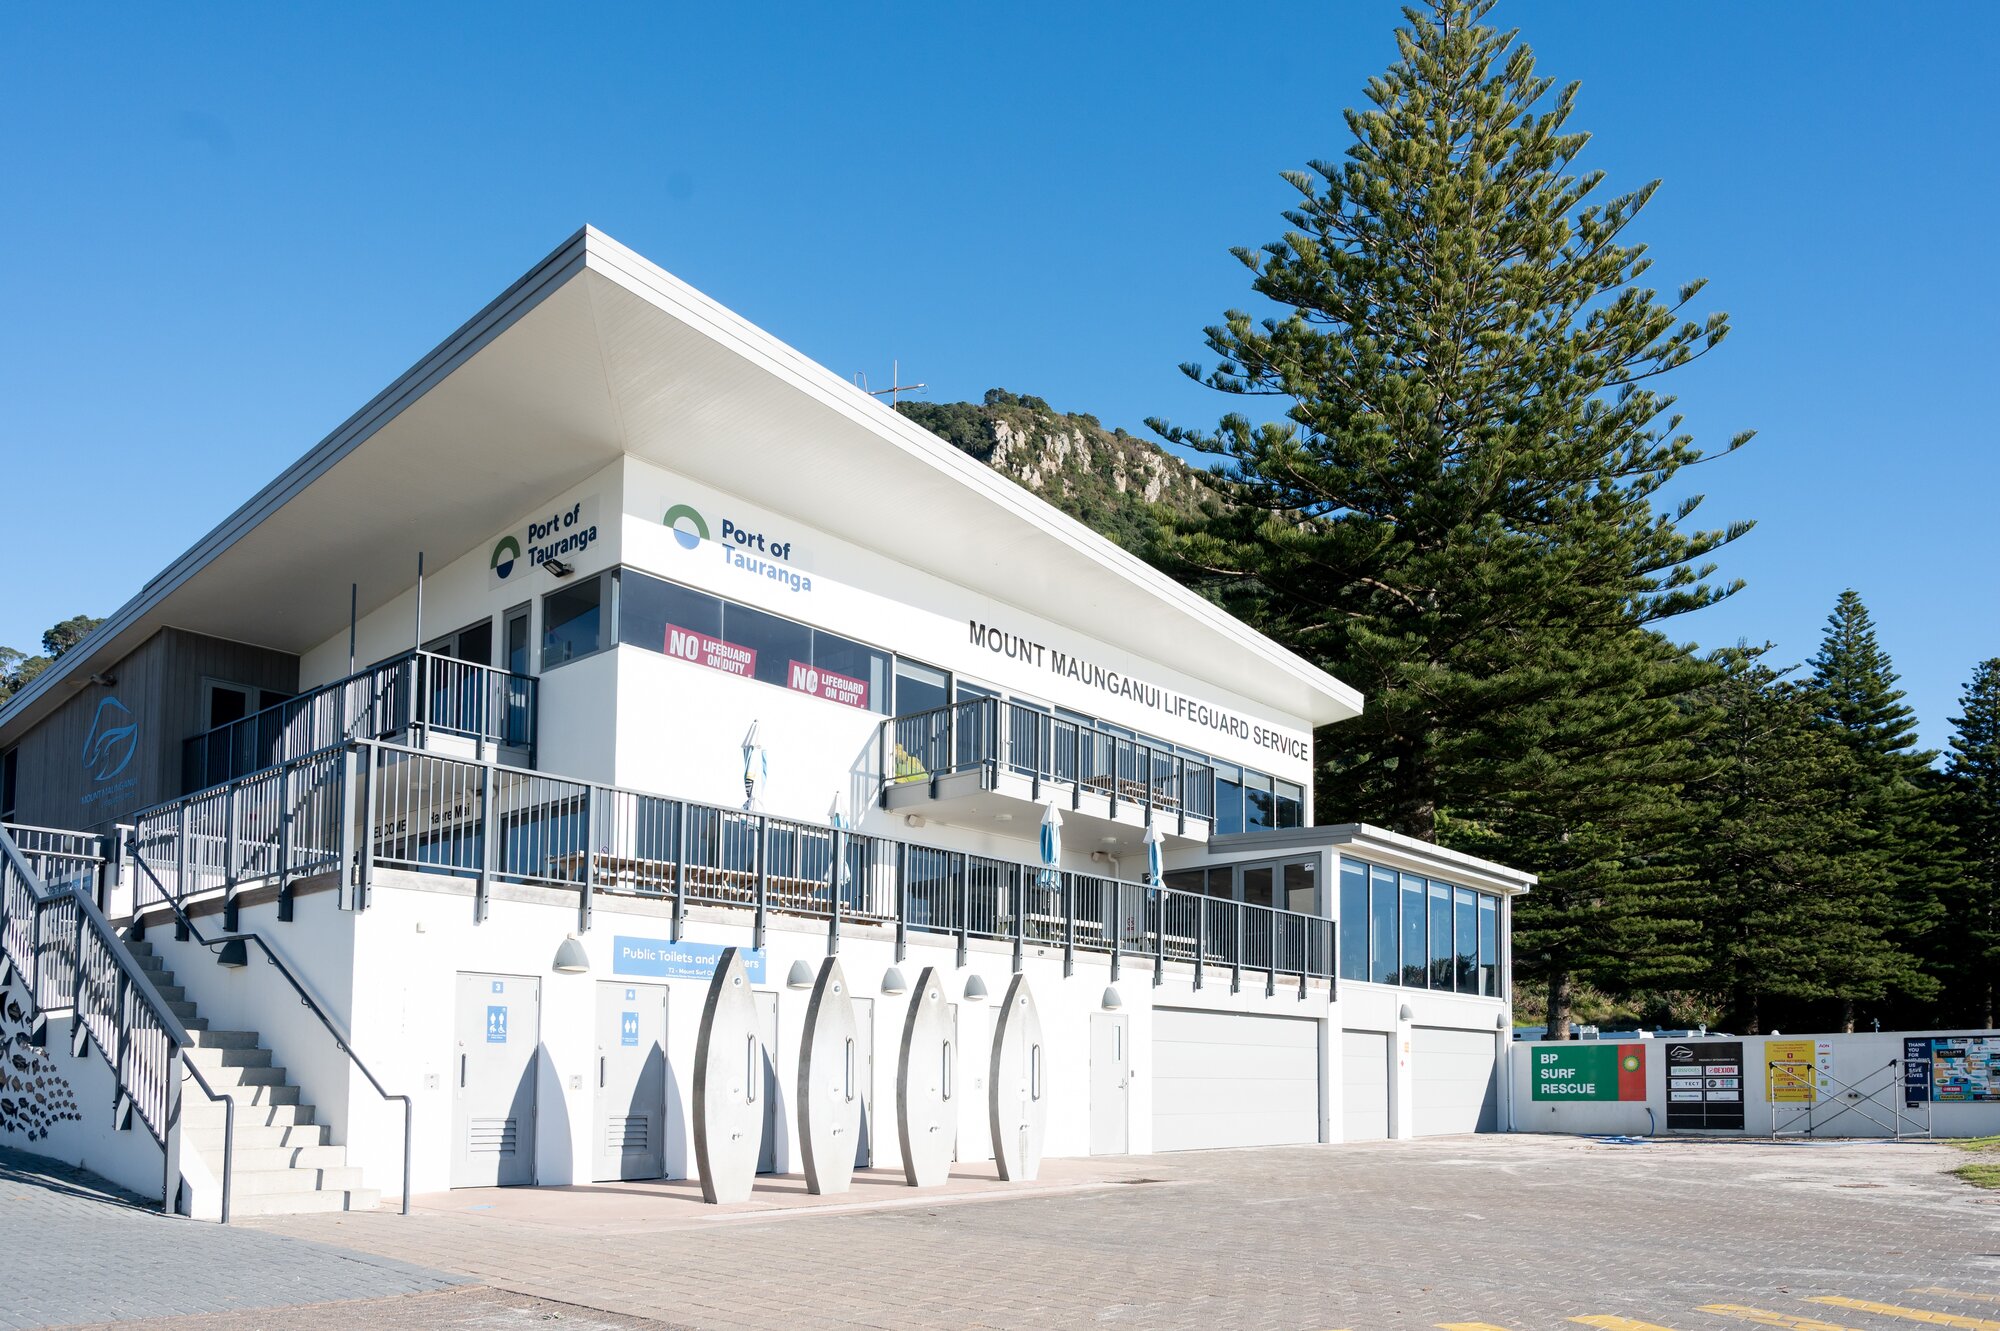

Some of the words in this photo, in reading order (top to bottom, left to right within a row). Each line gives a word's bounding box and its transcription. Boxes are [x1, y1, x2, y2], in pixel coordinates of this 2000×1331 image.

[528, 514, 559, 544] Port
[564, 502, 580, 527] of
[528, 525, 597, 567] Tauranga
[722, 518, 765, 552] Port
[770, 542, 791, 560] of
[722, 543, 812, 592] Tauranga
[669, 629, 699, 660] NO
[703, 639, 751, 664] LIFEGUARD
[707, 654, 721, 668] ON
[722, 658, 745, 675] DUTY
[792, 665, 818, 693] NO
[821, 673, 864, 695] LIFEGUARD
[825, 686, 837, 699] ON
[839, 690, 859, 704] DUTY
[970, 620, 1046, 667] MOUNT
[1051, 649, 1160, 709] MAUNGANUI
[1164, 692, 1249, 740] LIFEGUARD
[1253, 725, 1308, 762] SERVICE
[374, 819, 407, 839] ELCOME
[623, 947, 656, 961] Public
[658, 950, 693, 964] Toilets
[695, 954, 715, 965] and
[495, 983, 501, 991] 3
[1540, 1053, 1558, 1064] BP
[1540, 1068, 1575, 1079] SURF
[1541, 1083, 1596, 1094] RESCUE
